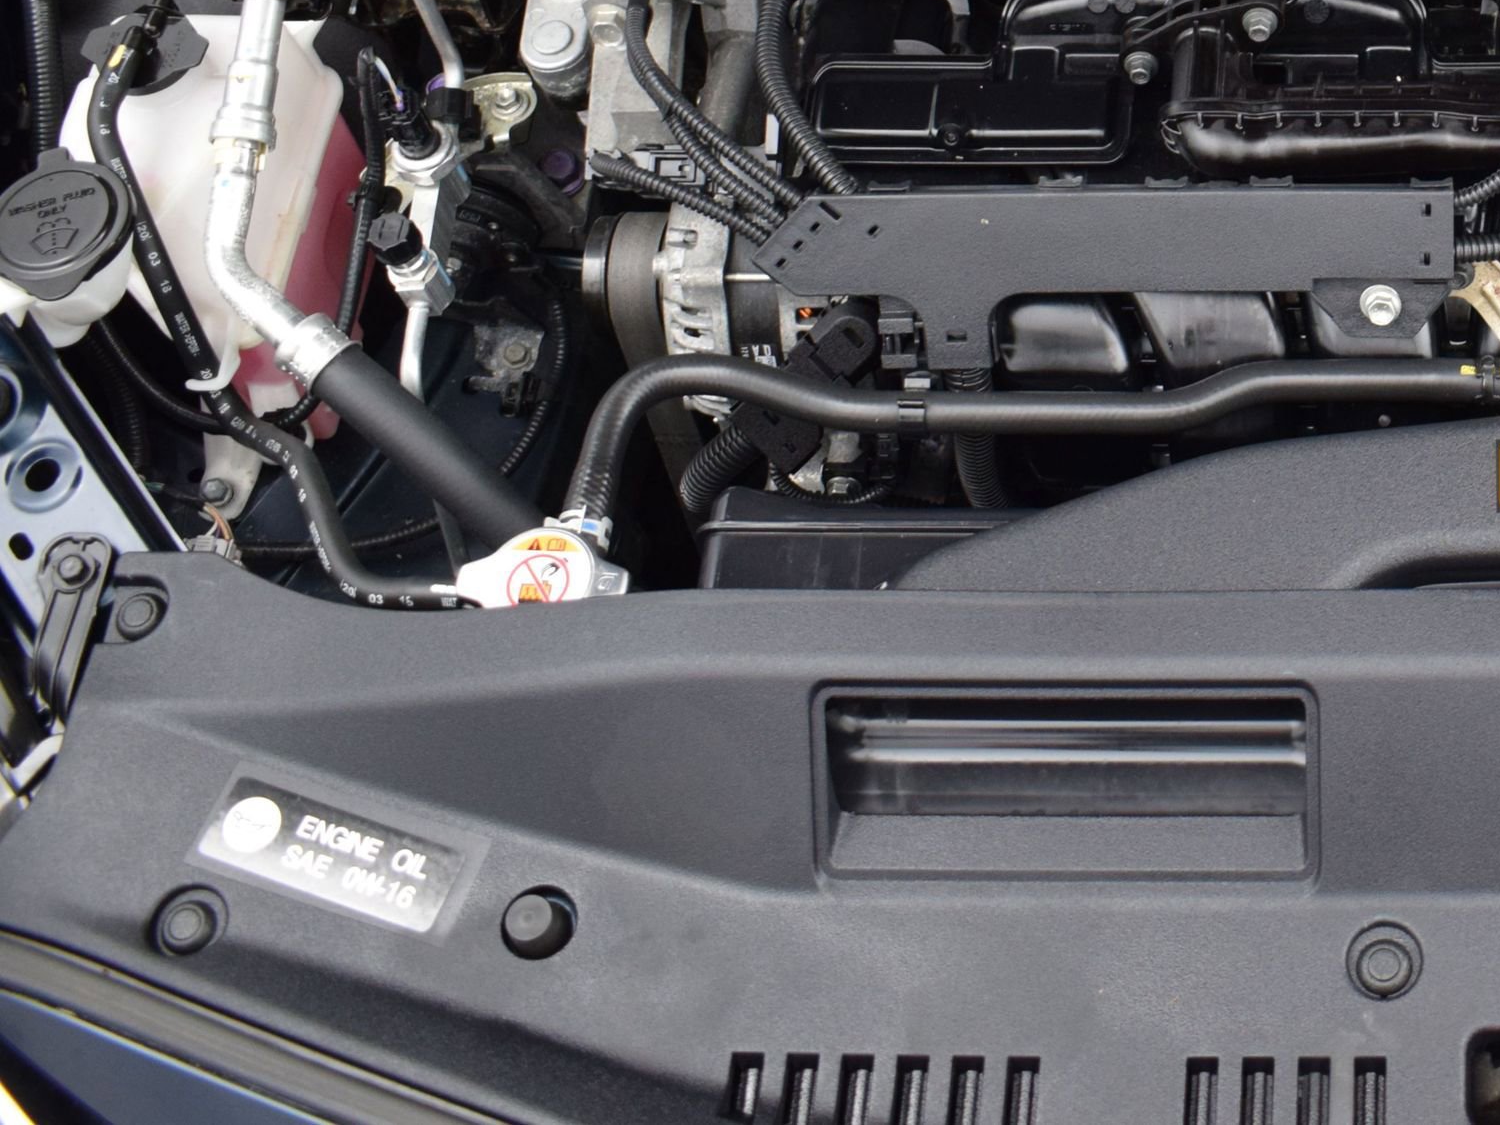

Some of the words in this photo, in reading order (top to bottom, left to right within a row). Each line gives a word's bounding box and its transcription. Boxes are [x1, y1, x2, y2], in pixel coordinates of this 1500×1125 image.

[8, 197, 57, 217] WASHER
[64, 188, 95, 202] FLUID
[38, 204, 68, 219] ONLY
[148, 251, 161, 267] 03
[160, 280, 173, 293] 18
[173, 312, 189, 334] WATER
[368, 593, 384, 606] 03
[295, 815, 384, 862] ENGINE
[391, 849, 428, 880] OIL
[281, 845, 333, 879] SAE
[342, 866, 417, 909] 0W-16
